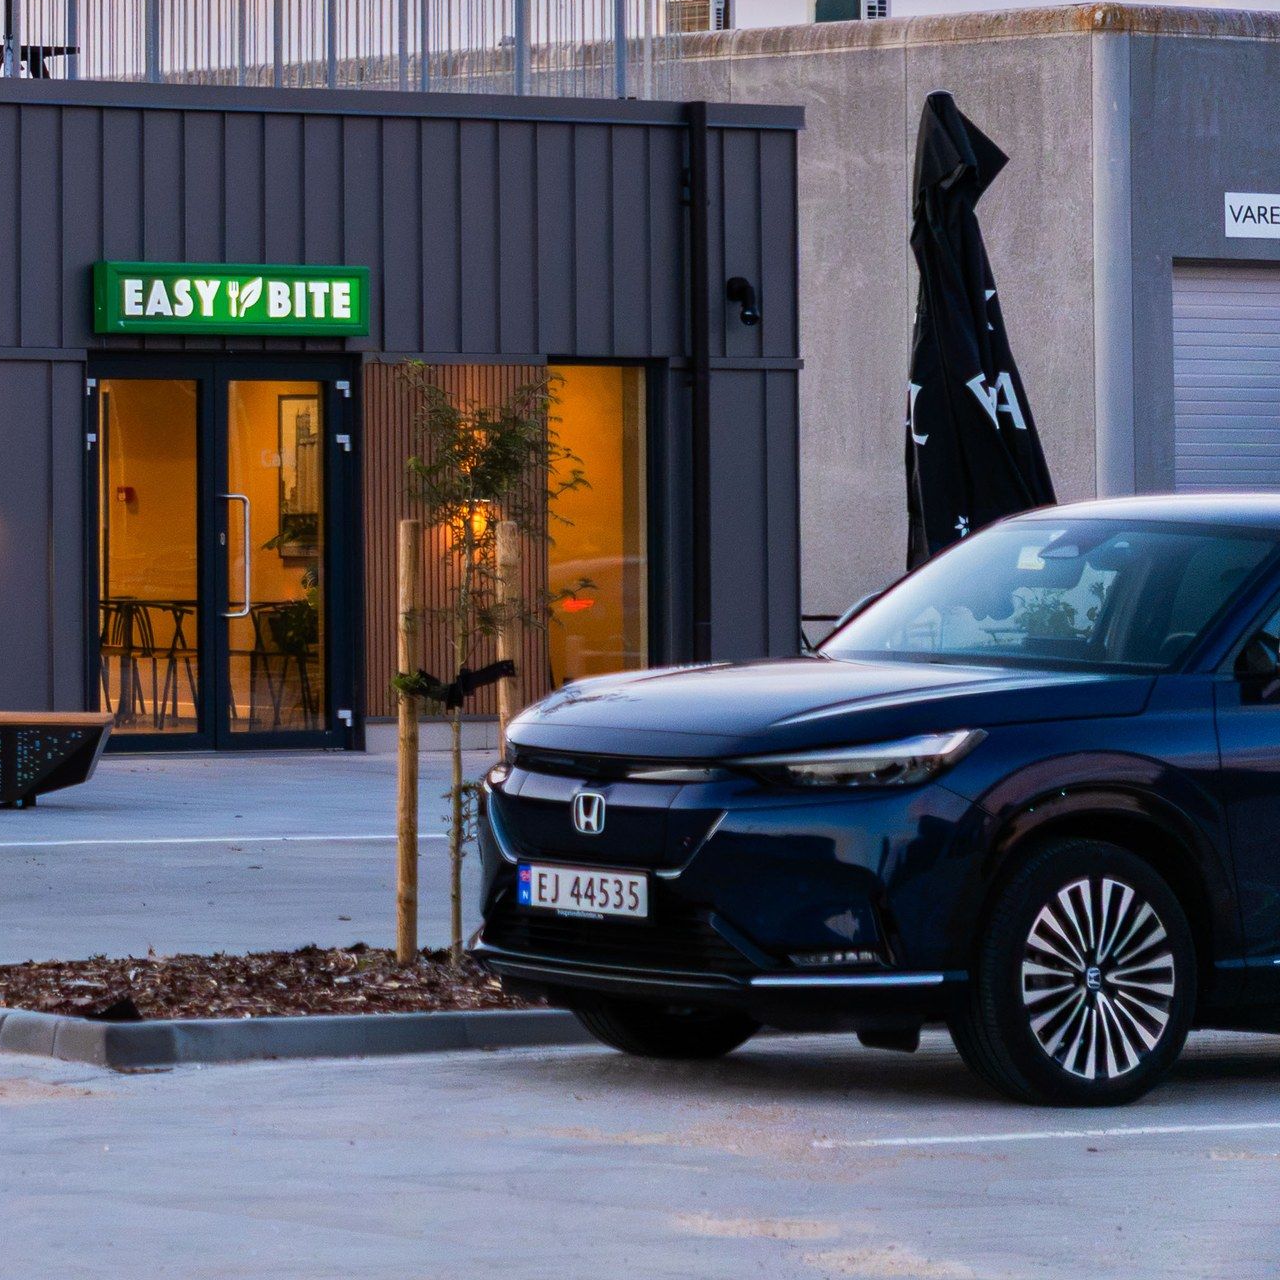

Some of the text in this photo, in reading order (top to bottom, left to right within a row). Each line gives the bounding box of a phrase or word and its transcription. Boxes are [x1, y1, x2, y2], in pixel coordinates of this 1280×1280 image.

[124, 278, 351, 319] EASY BITE
[538, 873, 640, 911] EJ 44535
